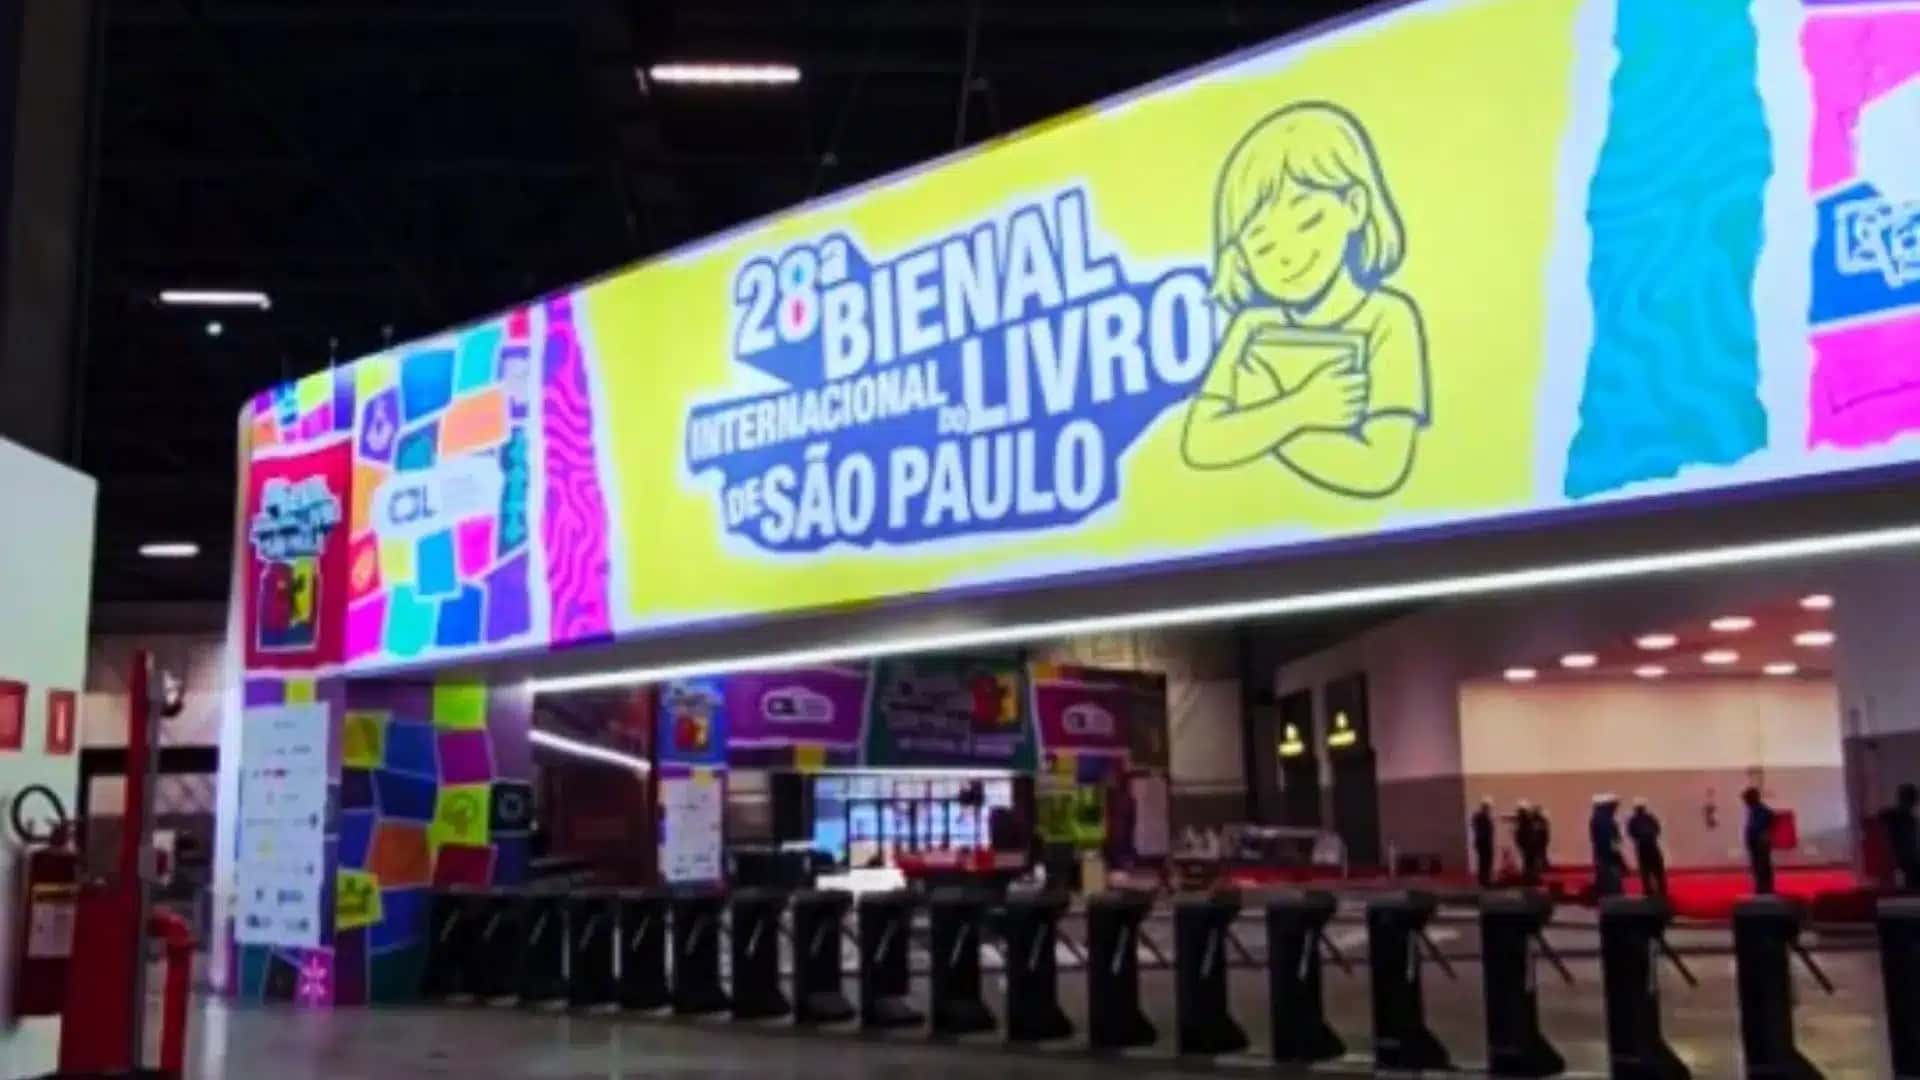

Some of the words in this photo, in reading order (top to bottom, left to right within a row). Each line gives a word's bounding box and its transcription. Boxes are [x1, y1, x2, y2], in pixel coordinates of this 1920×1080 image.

[691, 360, 948, 460] INTERNACIONAL
[962, 274, 1213, 433] LIVRO
[737, 237, 848, 355] 28ª
[825, 189, 1116, 379] BIENAL
[727, 483, 762, 528] DE
[762, 441, 876, 543] SÃO
[888, 419, 1104, 528] PAULO
